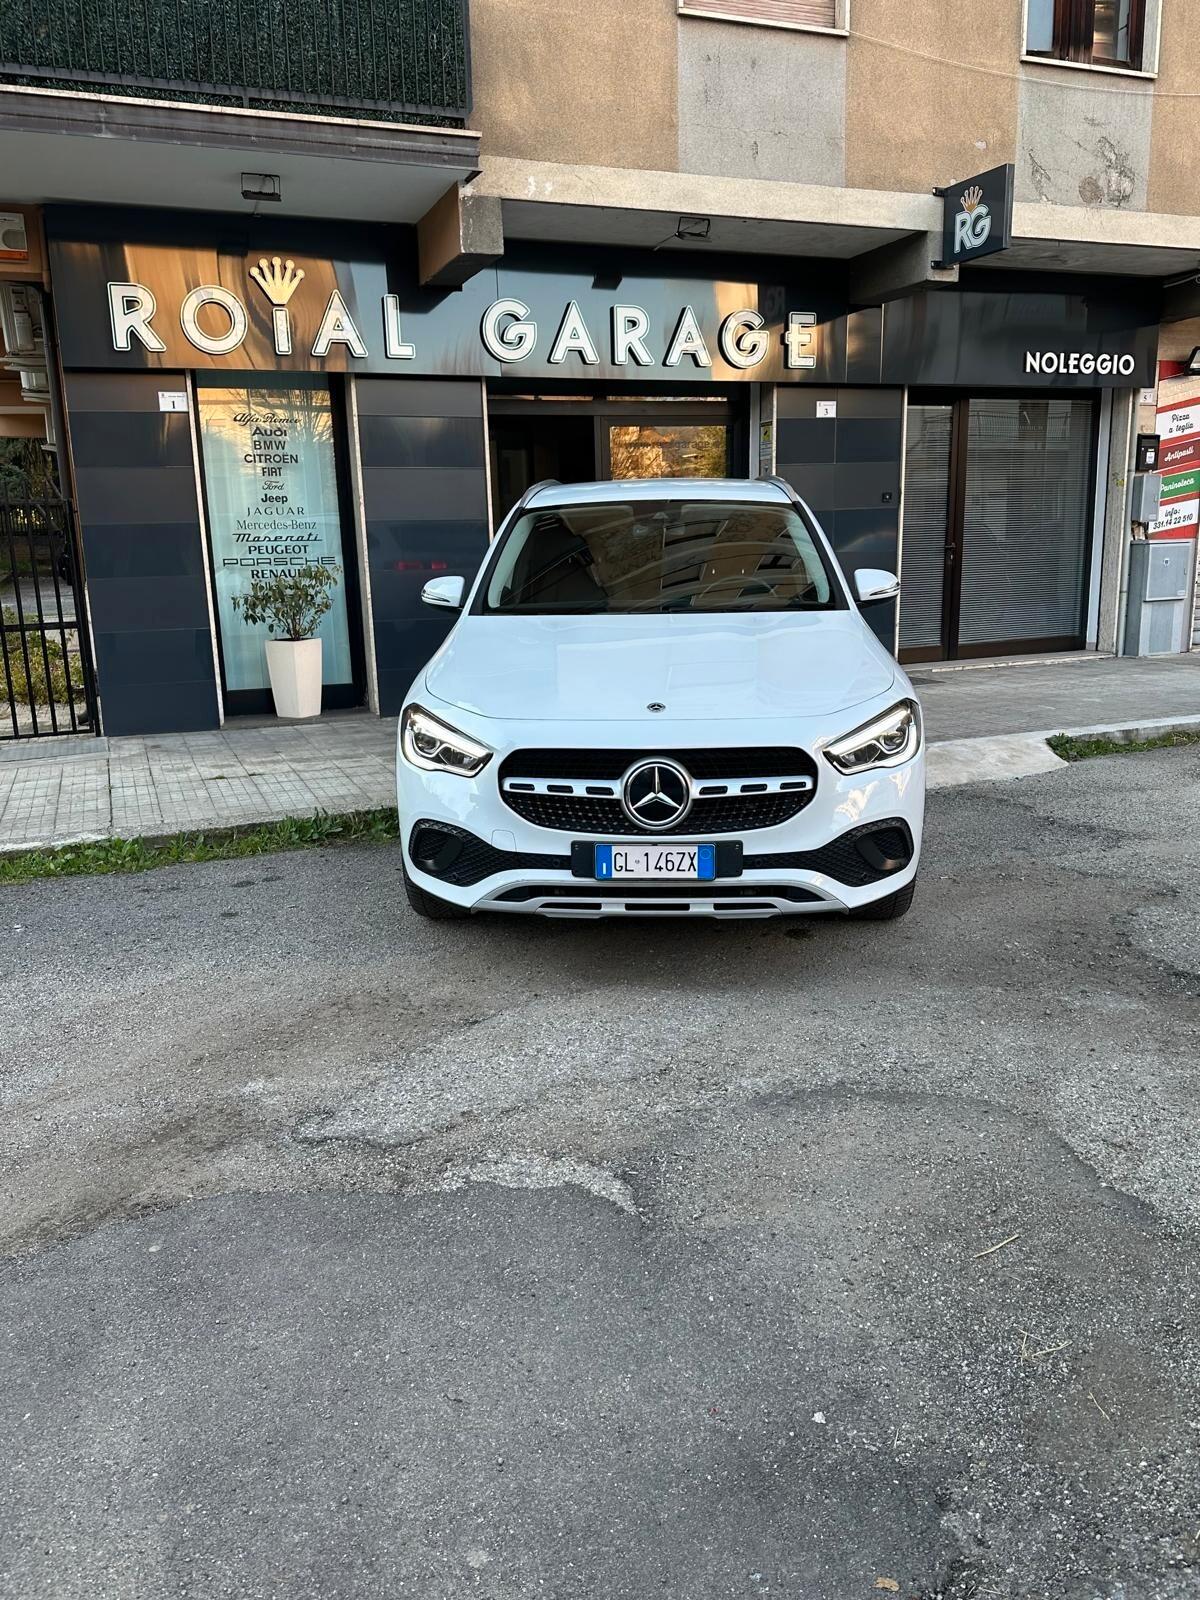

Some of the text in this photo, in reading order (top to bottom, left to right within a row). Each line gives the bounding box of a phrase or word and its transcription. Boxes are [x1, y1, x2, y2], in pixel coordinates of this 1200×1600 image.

[954, 204, 992, 254] RG
[482, 298, 817, 369] GARAGE
[1025, 351, 1135, 376] NOLEGGIO
[171, 400, 176, 409] 1
[823, 408, 829, 416] 3
[233, 412, 302, 426] Alfa Romeo
[1171, 413, 1190, 423] Pizza
[252, 426, 287, 437] Audi
[253, 440, 286, 451] BMW
[243, 452, 299, 464] CITROËN
[1164, 445, 1195, 462] Antipasti
[262, 466, 283, 477] FIAT
[262, 480, 285, 491] Ford
[261, 493, 289, 504] Jeep
[247, 506, 305, 517] JAGUAR
[236, 520, 317, 530] Mercedes-Benz
[232, 532, 323, 543] Maserati
[248, 544, 309, 555] PEUGEOT
[222, 556, 336, 567] PORSCHE
[251, 569, 305, 579] RENAUL
[613, 851, 698, 873] GL 146ZX
